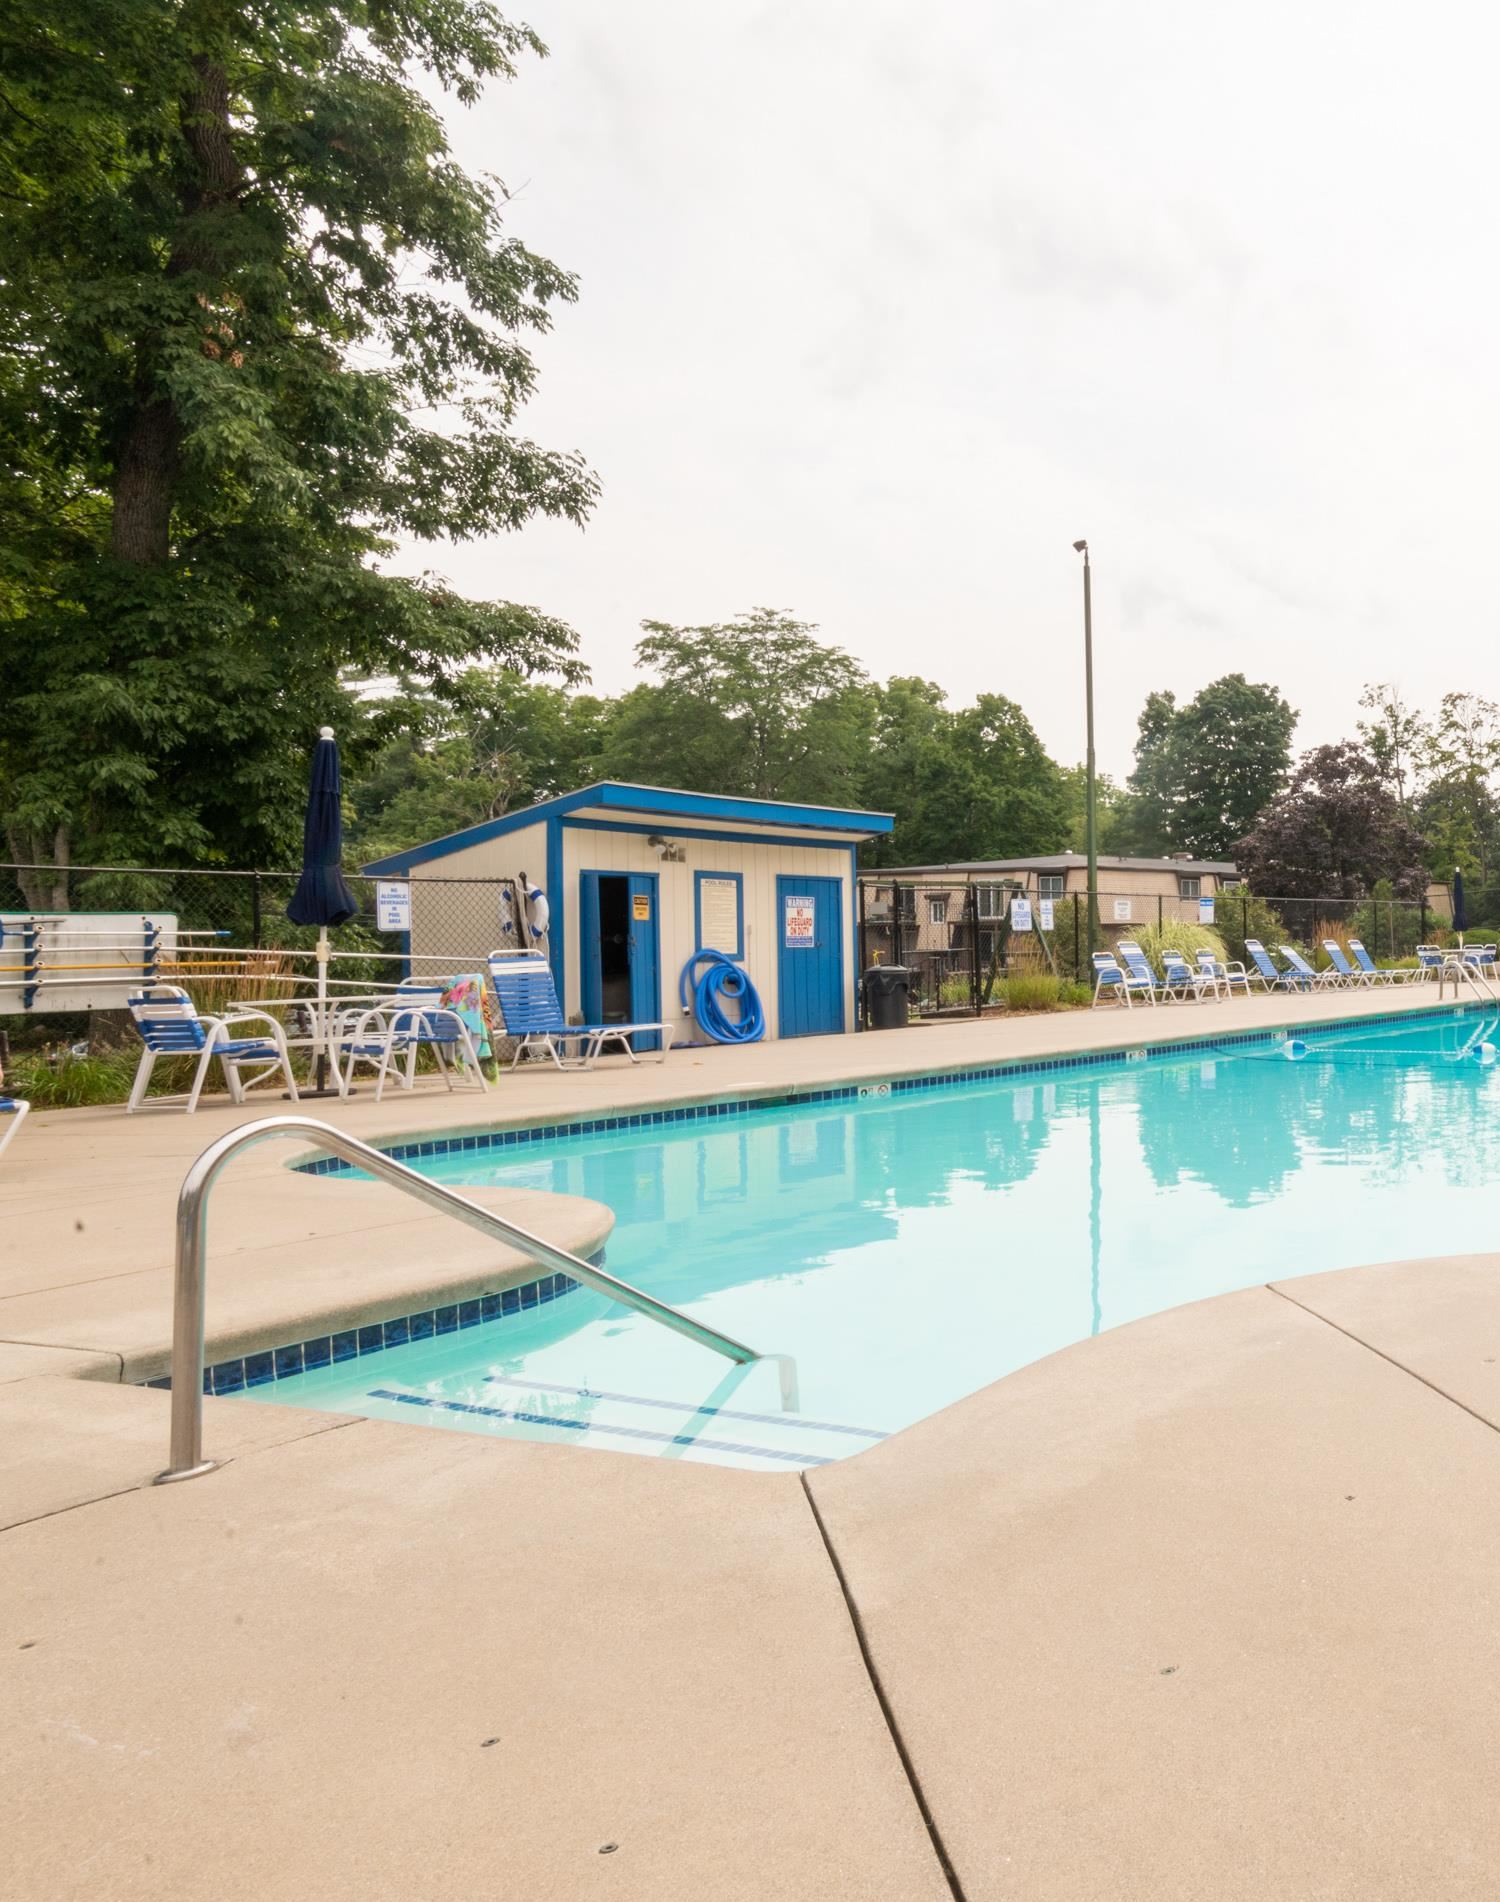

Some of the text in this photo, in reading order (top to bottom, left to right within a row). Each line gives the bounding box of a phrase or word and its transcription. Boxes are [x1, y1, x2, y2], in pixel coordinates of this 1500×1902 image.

[1017, 902, 1025, 911] NO
[797, 908, 803, 917] NO
[787, 917, 812, 926] LIFEGUARD
[790, 926, 809, 936] ON DUTY
